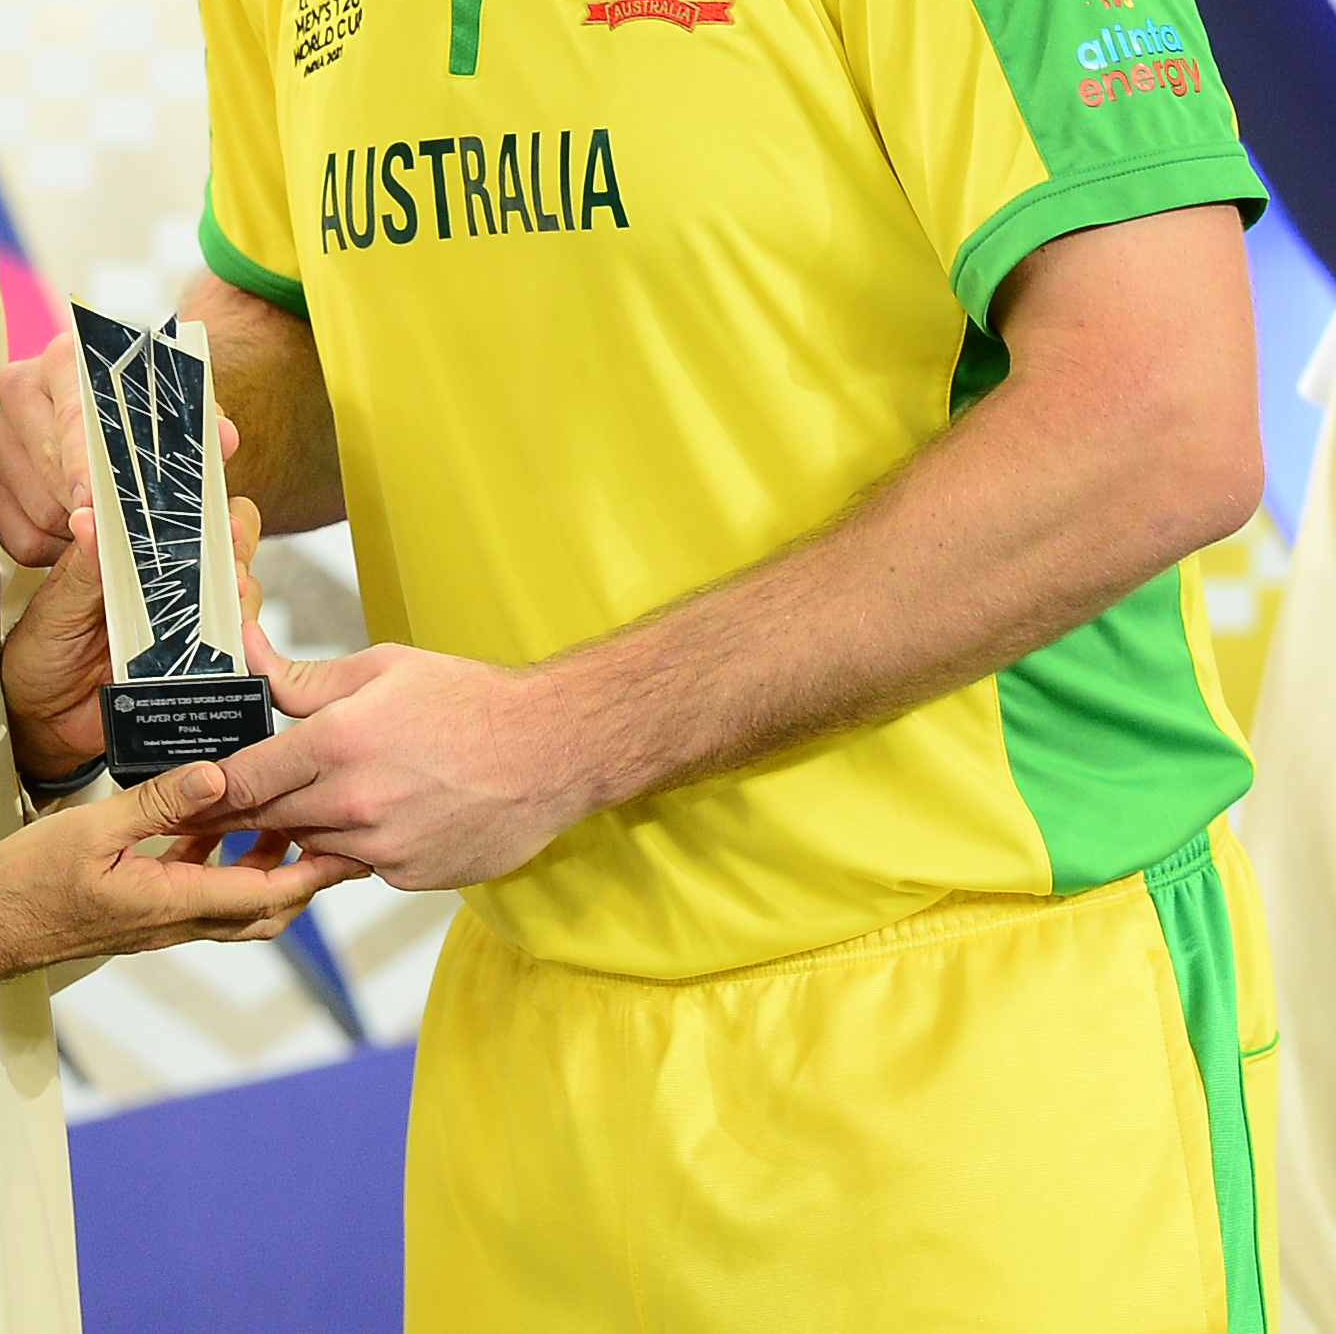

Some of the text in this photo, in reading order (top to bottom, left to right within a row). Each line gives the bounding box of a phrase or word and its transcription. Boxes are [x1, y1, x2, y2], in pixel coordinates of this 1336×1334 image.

[614, 0, 691, 22] AUSTRALIA
[293, 8, 363, 67] WORLD CUP
[1077, 18, 1184, 71] alinta
[1078, 57, 1201, 107] energy
[321, 128, 630, 254] AUSTRALIA
[136, 710, 242, 723] PLAYER OF THE MATCH
[192, 696, 224, 704] WORLD
[225, 694, 243, 702] CUP
[178, 725, 202, 733] FINAL
